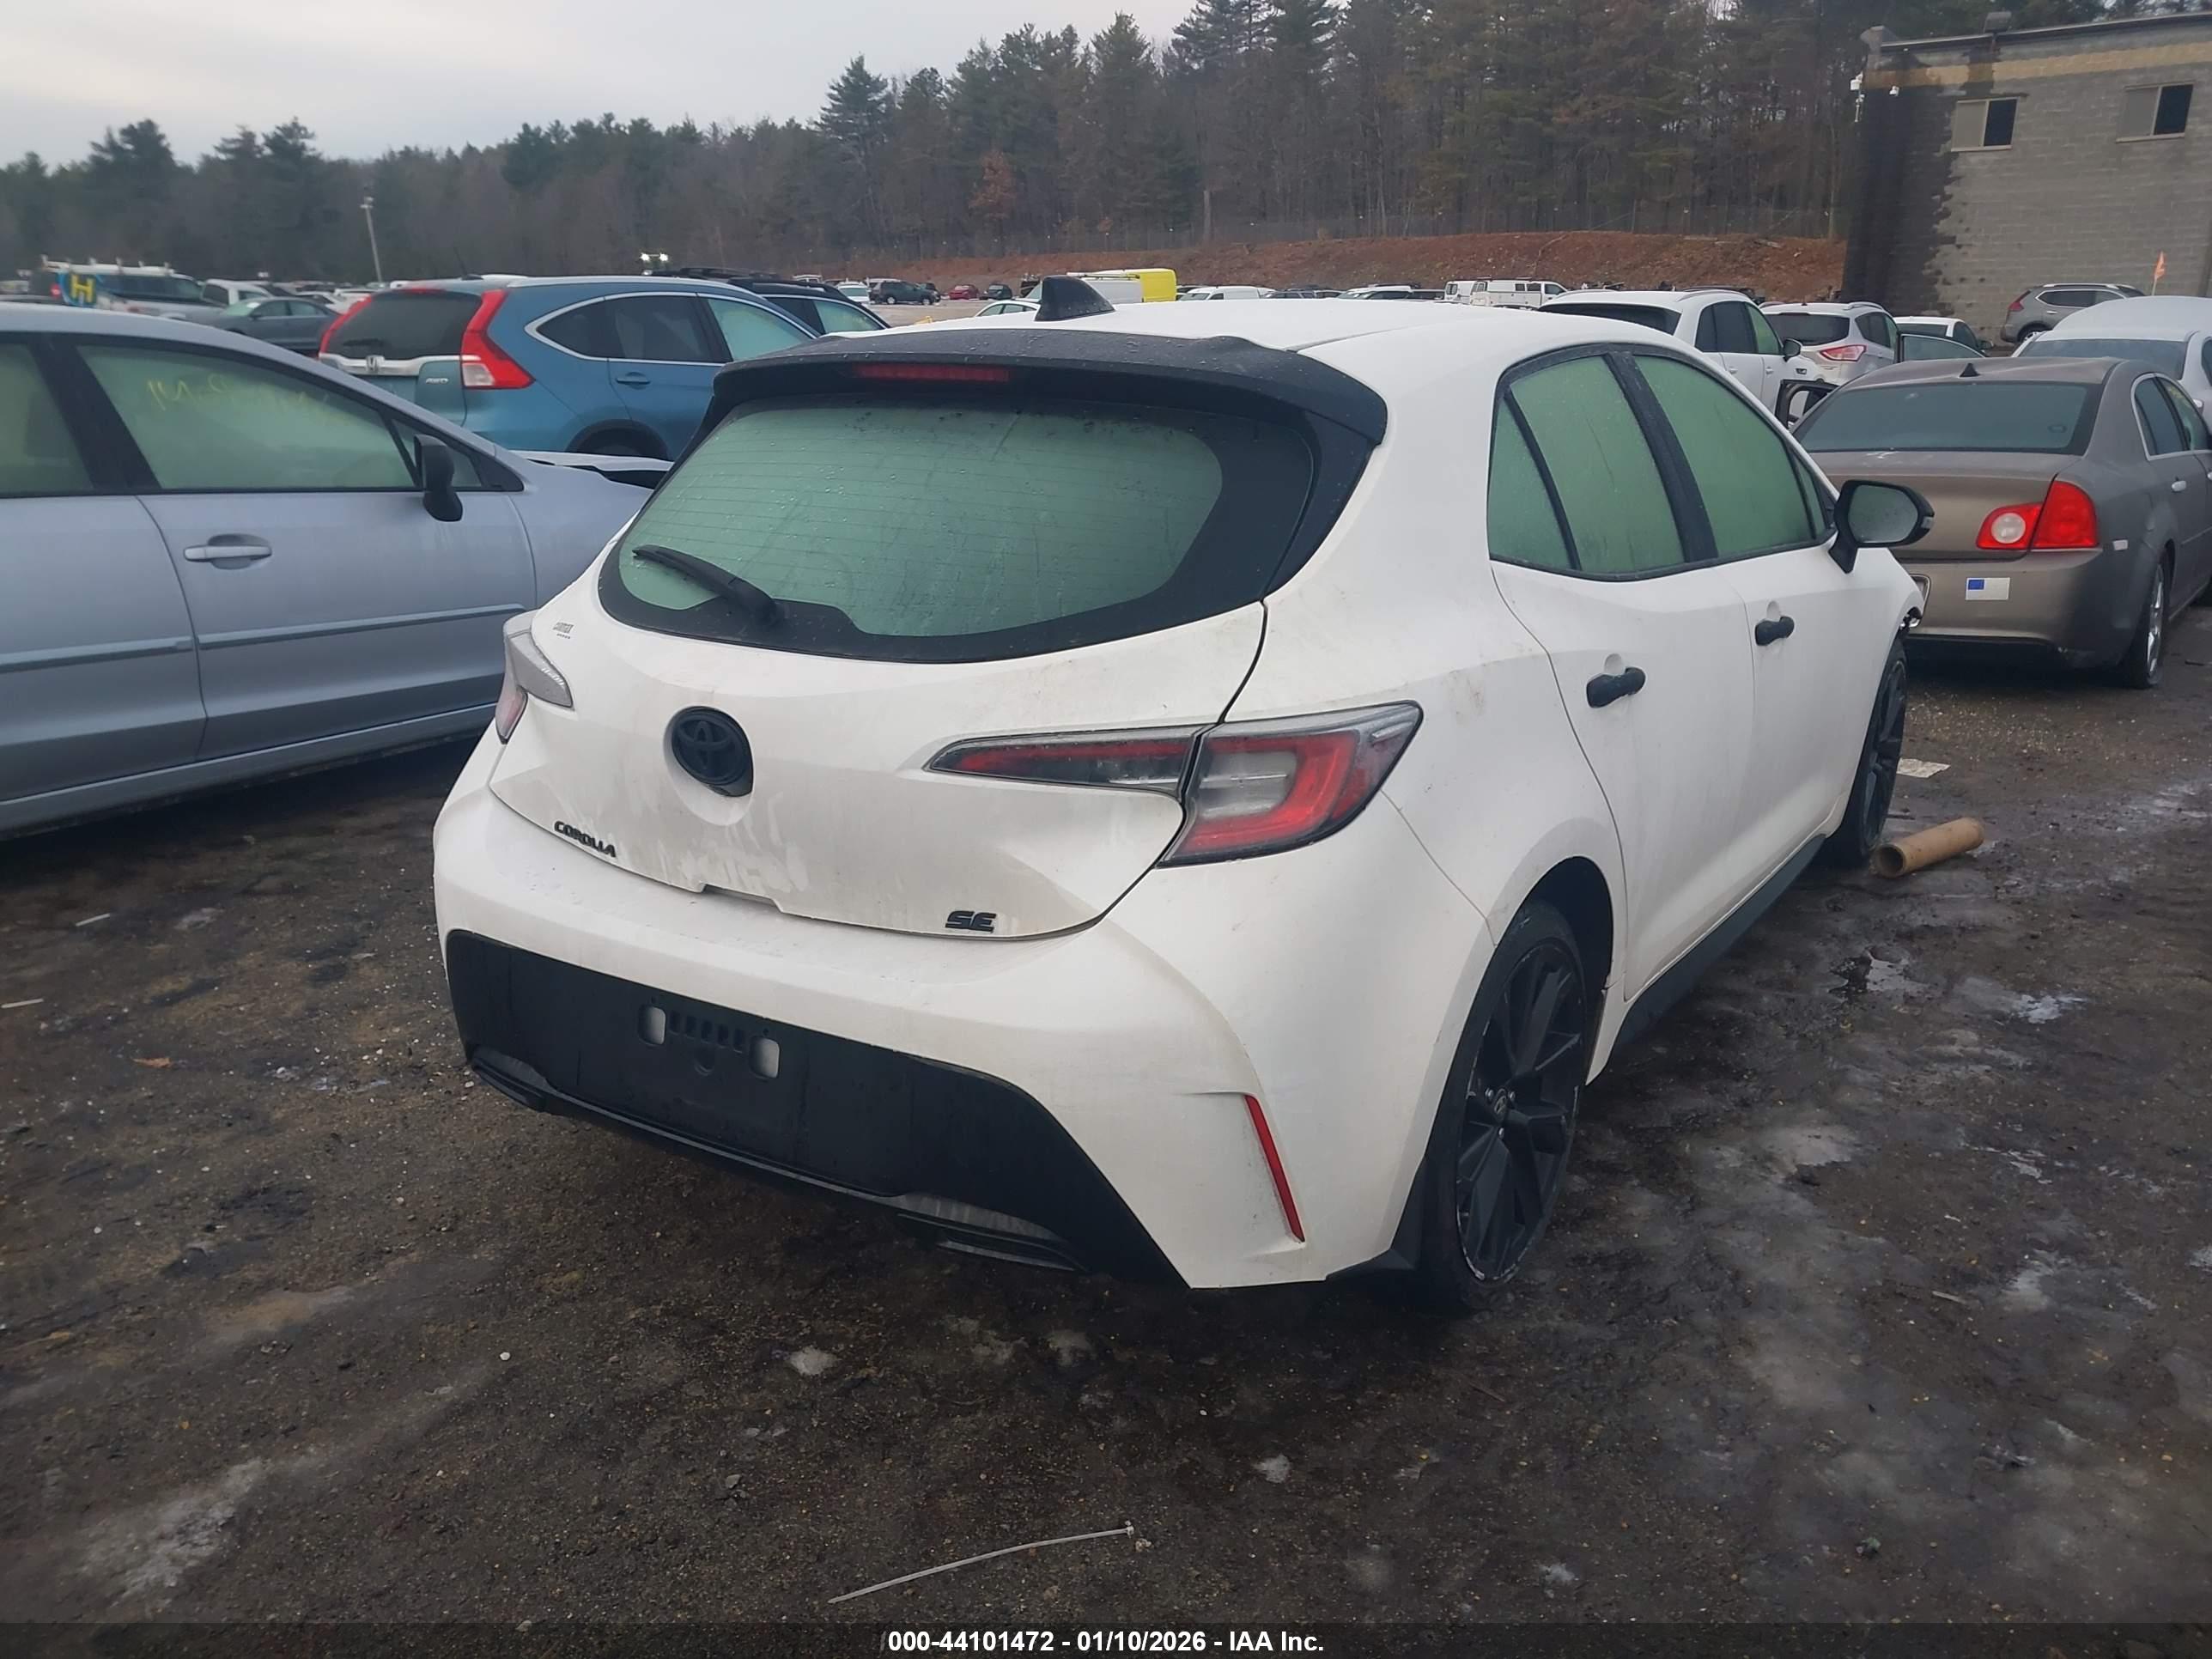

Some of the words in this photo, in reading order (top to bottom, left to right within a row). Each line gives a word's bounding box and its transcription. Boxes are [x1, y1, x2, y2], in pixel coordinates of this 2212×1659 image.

[71, 275, 93, 302] H
[554, 820, 617, 858] COROLLA
[945, 910, 997, 933] SE
